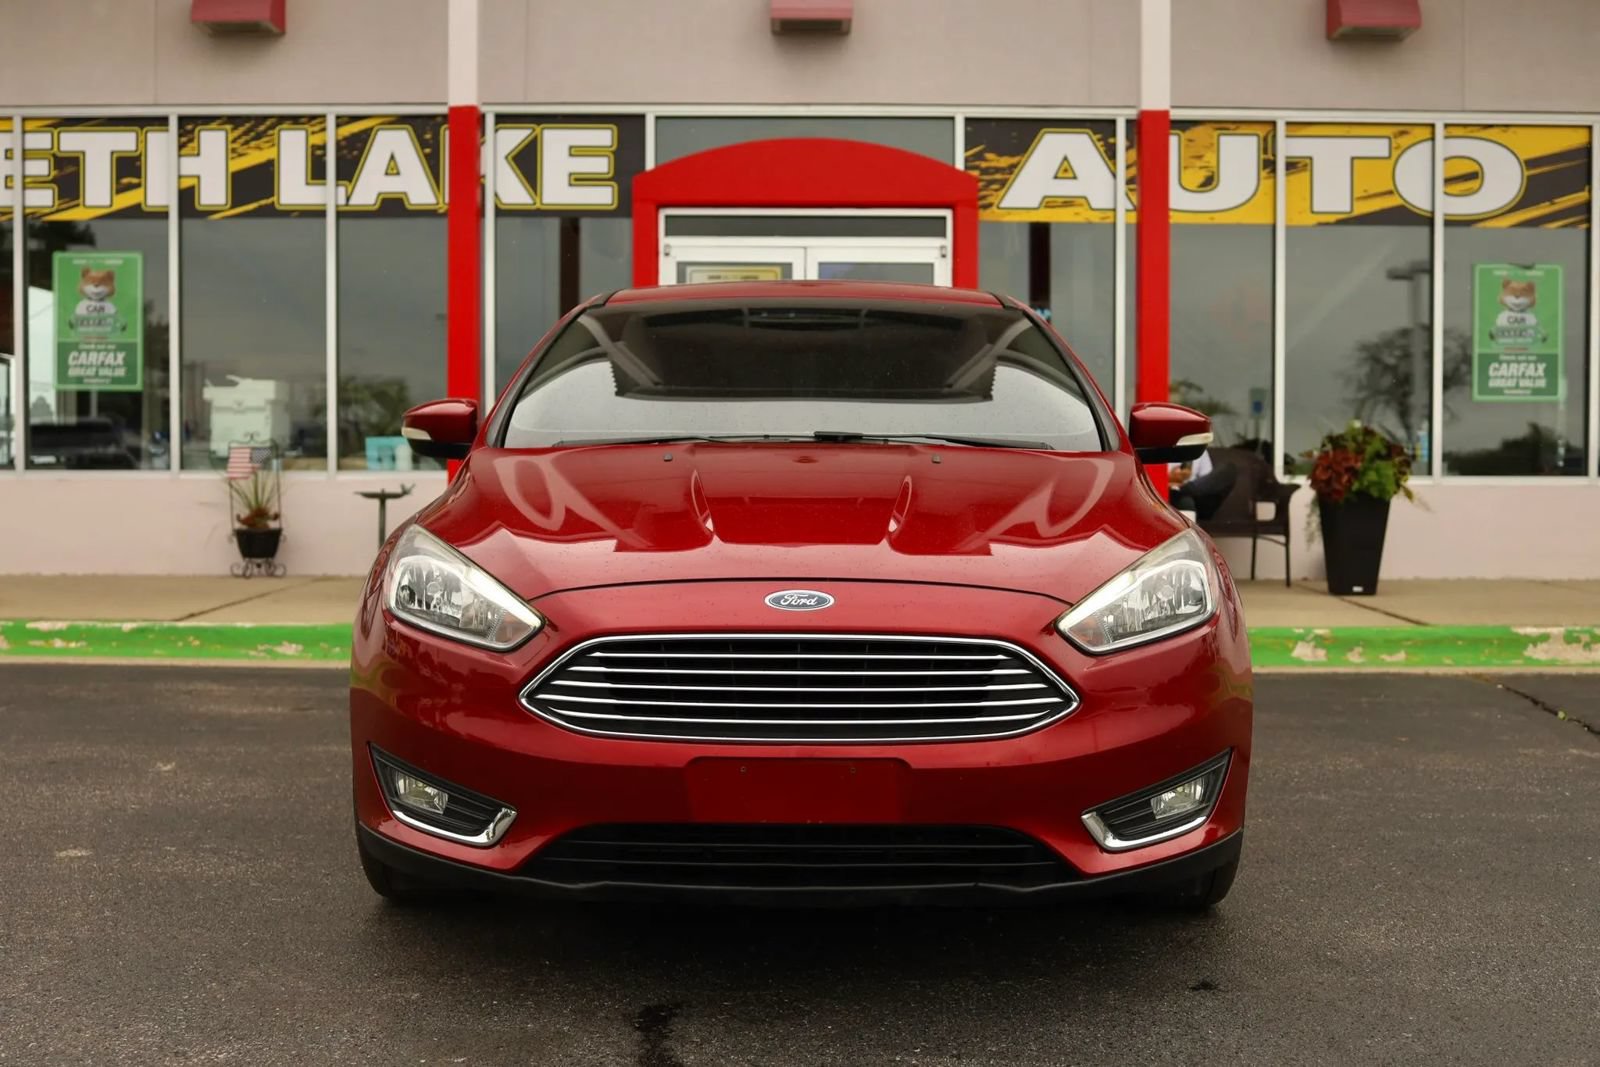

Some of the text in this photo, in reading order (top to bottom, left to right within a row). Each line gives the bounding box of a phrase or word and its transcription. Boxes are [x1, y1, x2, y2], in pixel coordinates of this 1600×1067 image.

[274, 124, 618, 210] LAKE
[997, 128, 1526, 217] AUTO
[68, 351, 126, 366] CARFAX
[1489, 363, 1547, 377] CARFAX
[781, 593, 818, 606] Ford
